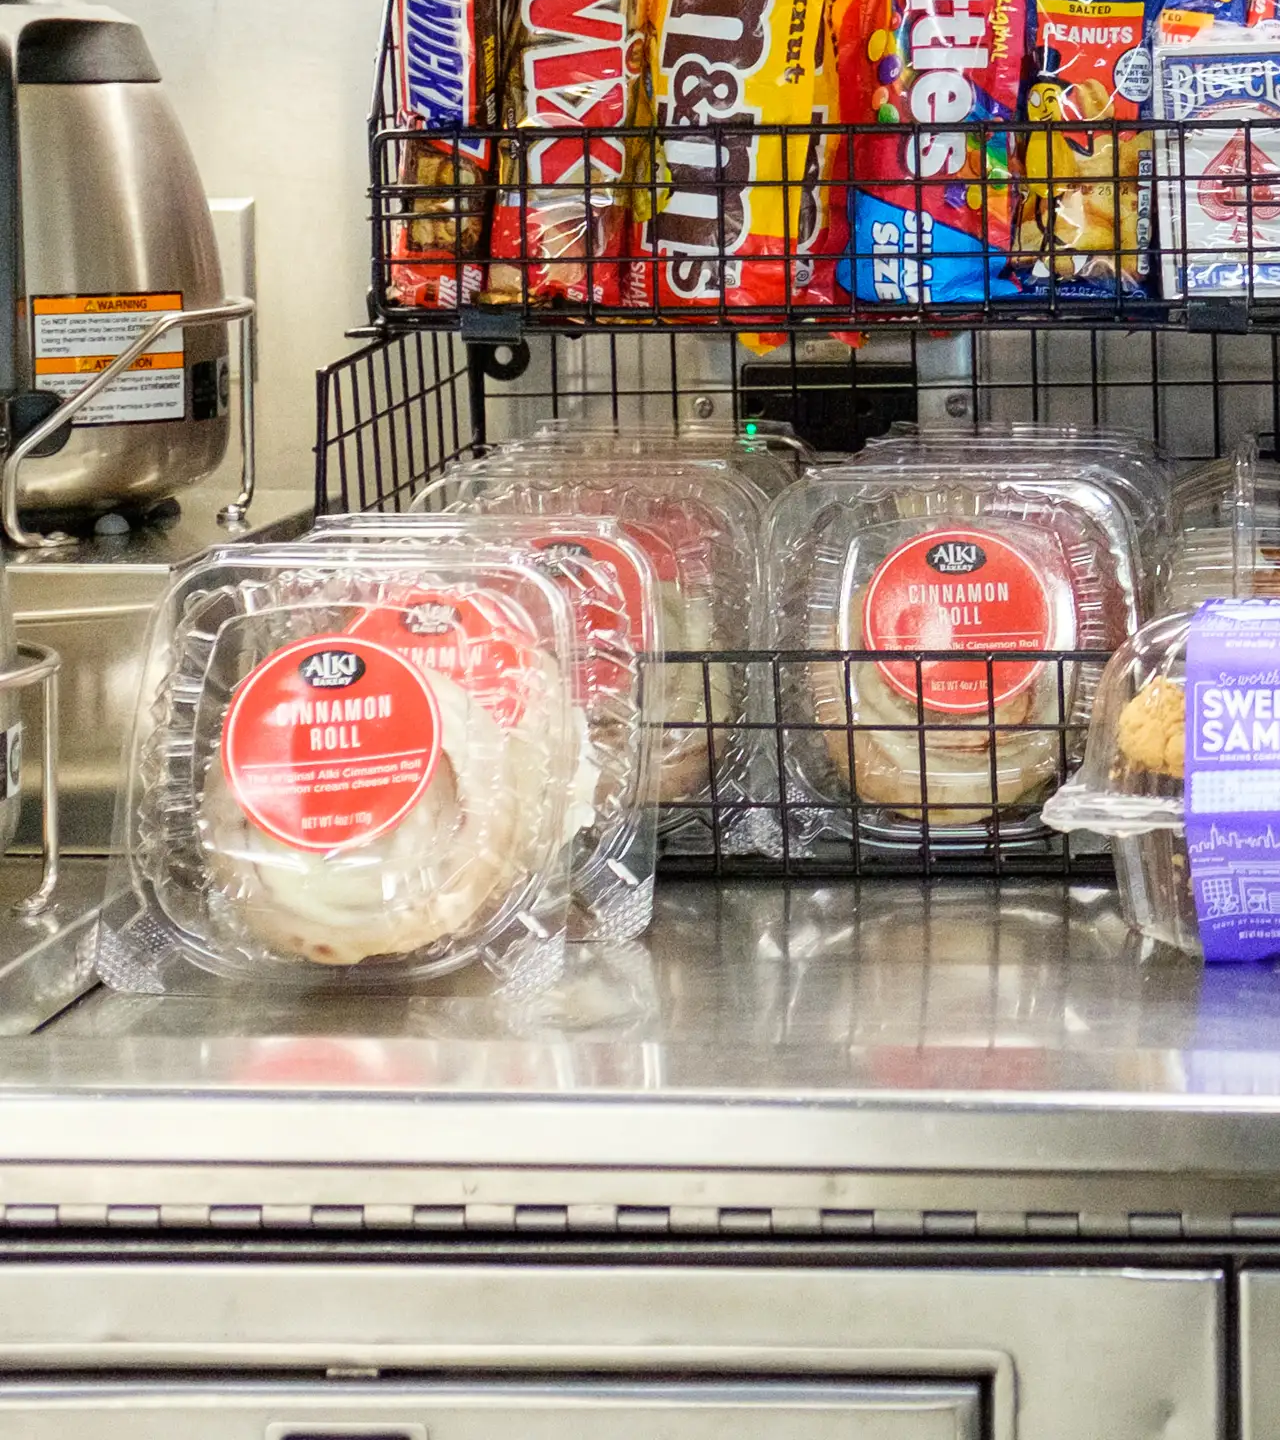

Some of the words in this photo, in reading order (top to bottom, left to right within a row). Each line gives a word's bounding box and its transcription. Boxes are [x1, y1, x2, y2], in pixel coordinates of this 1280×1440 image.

[1069, 4, 1112, 15] SALTED
[1043, 22, 1133, 44] PEANUTS
[97, 299, 148, 310] WARNING
[934, 543, 977, 565] ALKI
[908, 582, 1009, 605] CINNAMON
[938, 606, 982, 626] ROLL
[305, 651, 357, 679] ALKI
[313, 678, 351, 687] BAKERY
[276, 694, 392, 726] CINNAMON
[310, 726, 361, 751] ROLL
[342, 764, 398, 778] Cinnamon
[400, 759, 422, 769] Roll
[351, 777, 389, 790] cheese
